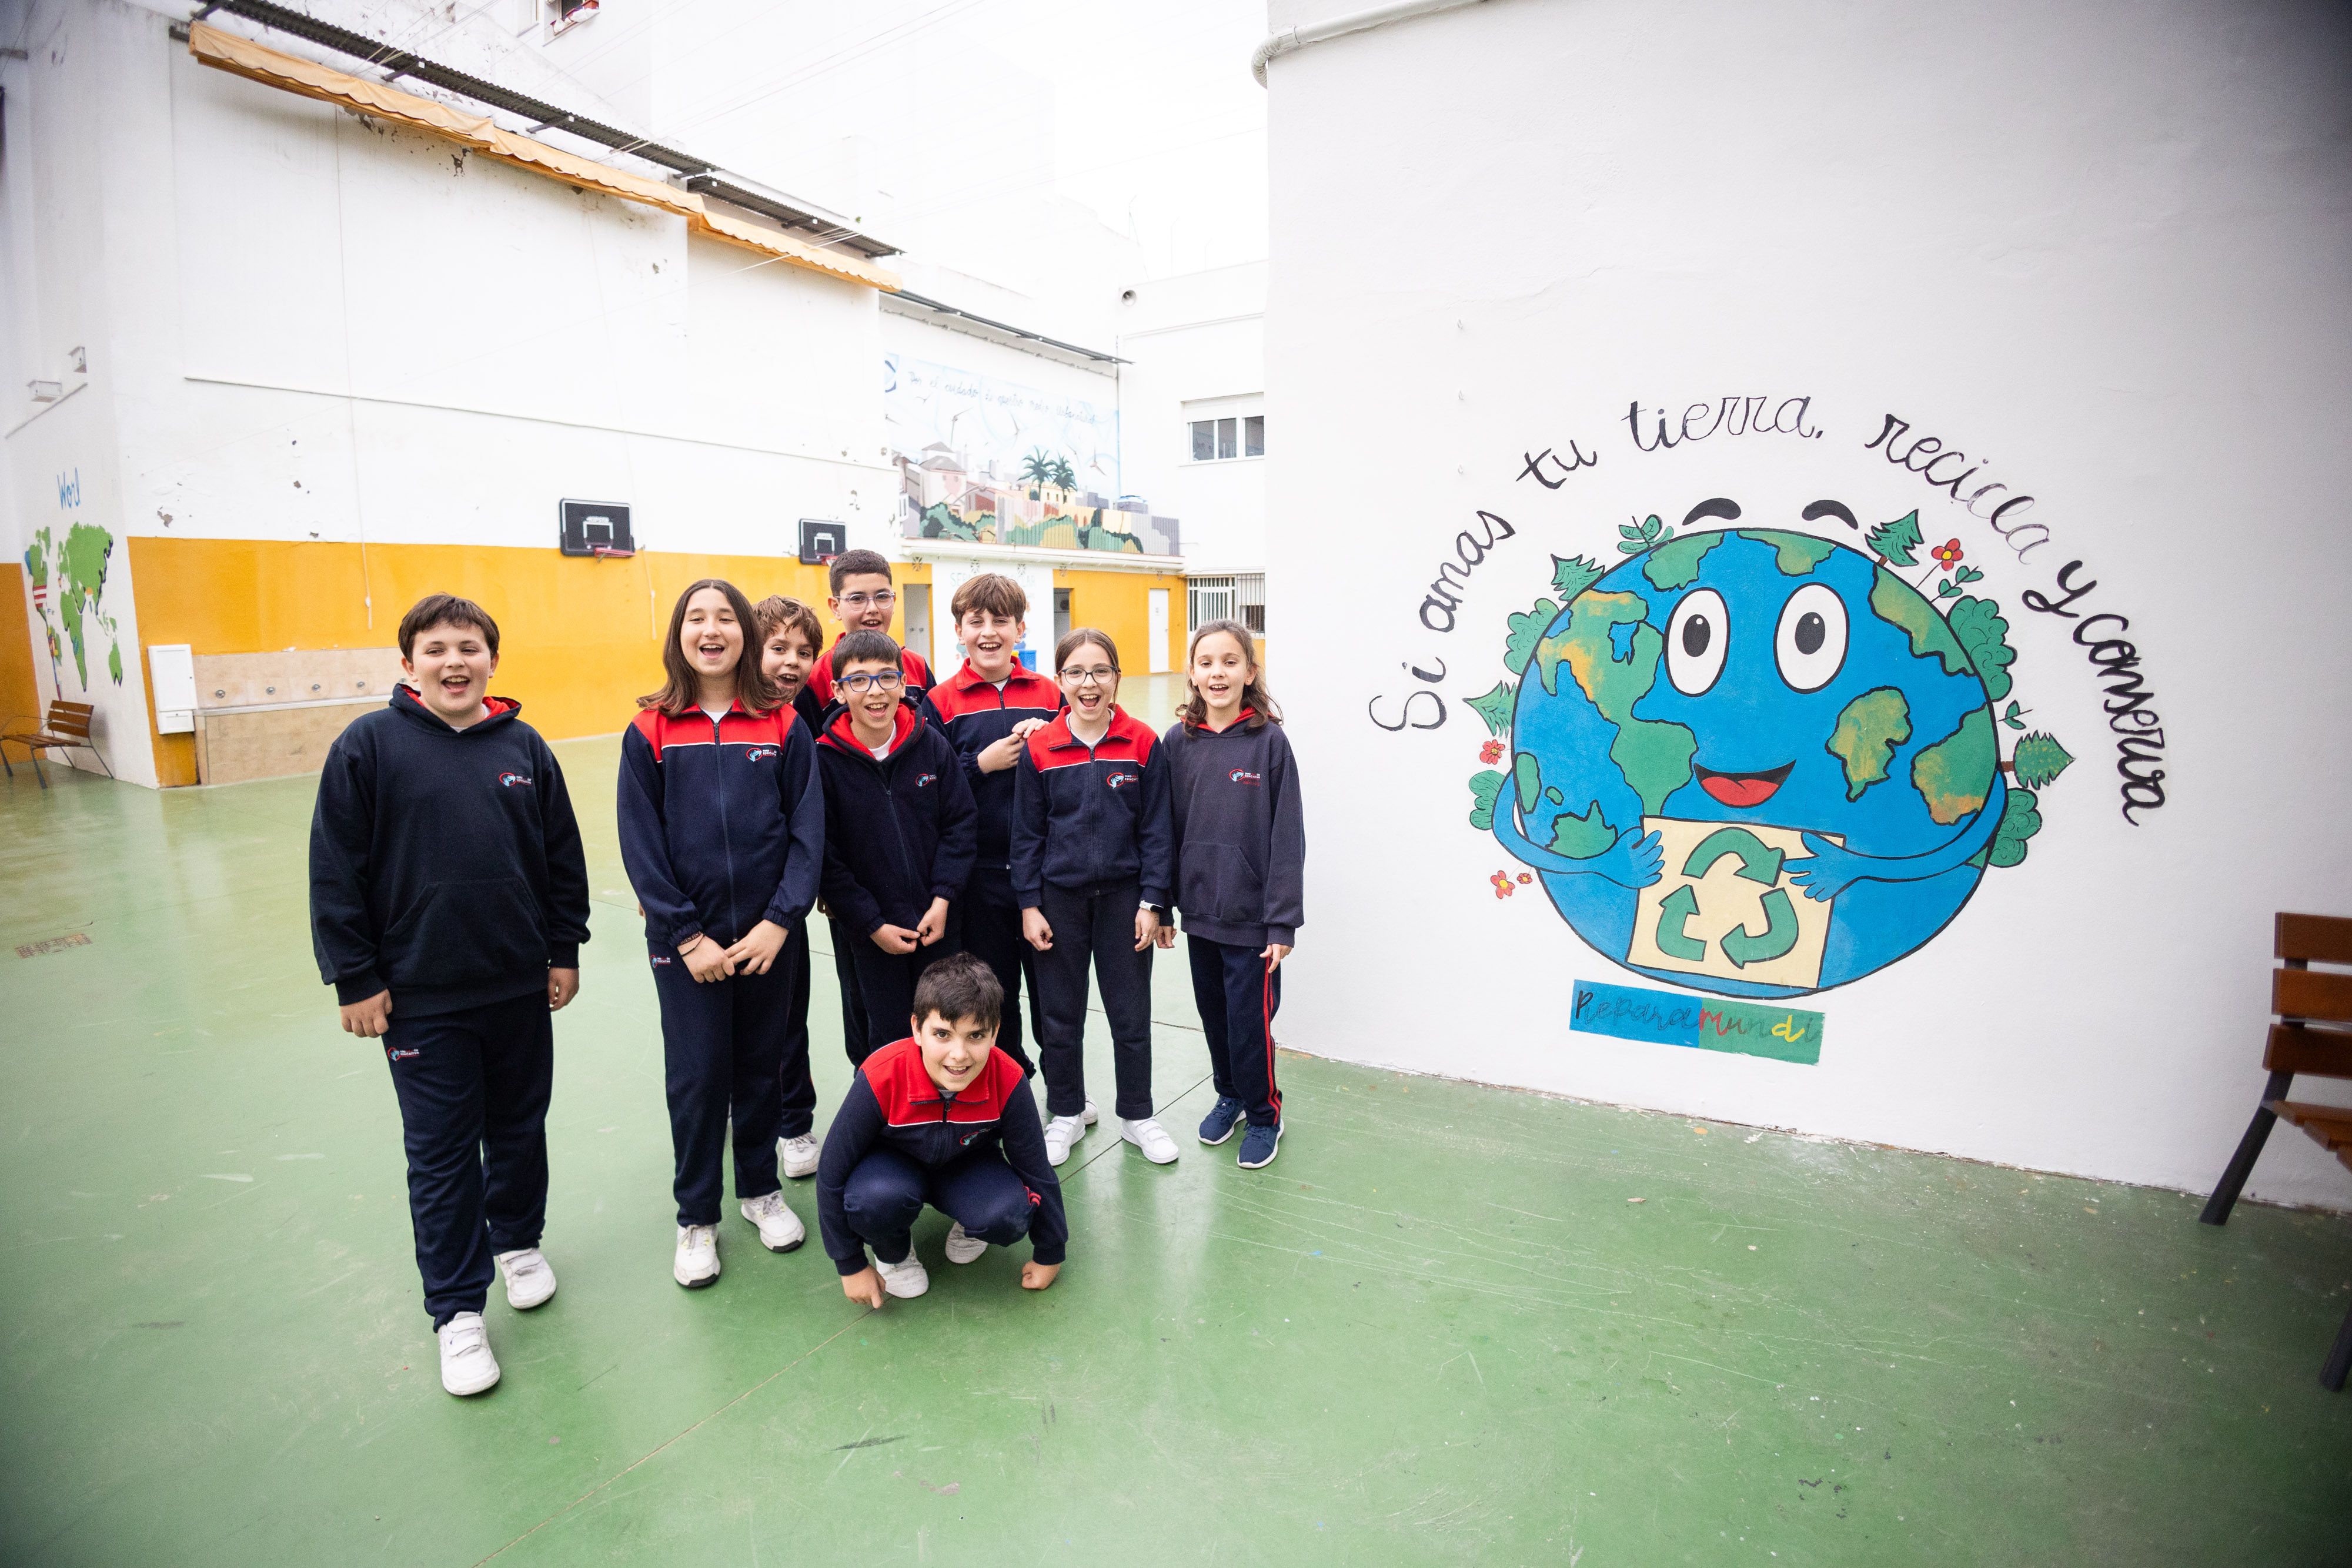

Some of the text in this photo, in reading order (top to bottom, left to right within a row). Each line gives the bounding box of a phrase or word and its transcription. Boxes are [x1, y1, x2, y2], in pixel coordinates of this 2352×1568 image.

[1368, 657, 1446, 731] Si
[1419, 510, 1516, 633] amas
[1515, 439, 1598, 489] tu
[1864, 413, 2050, 565] recicla
[2022, 560, 2097, 618] y
[2073, 613, 2166, 827] conserva
